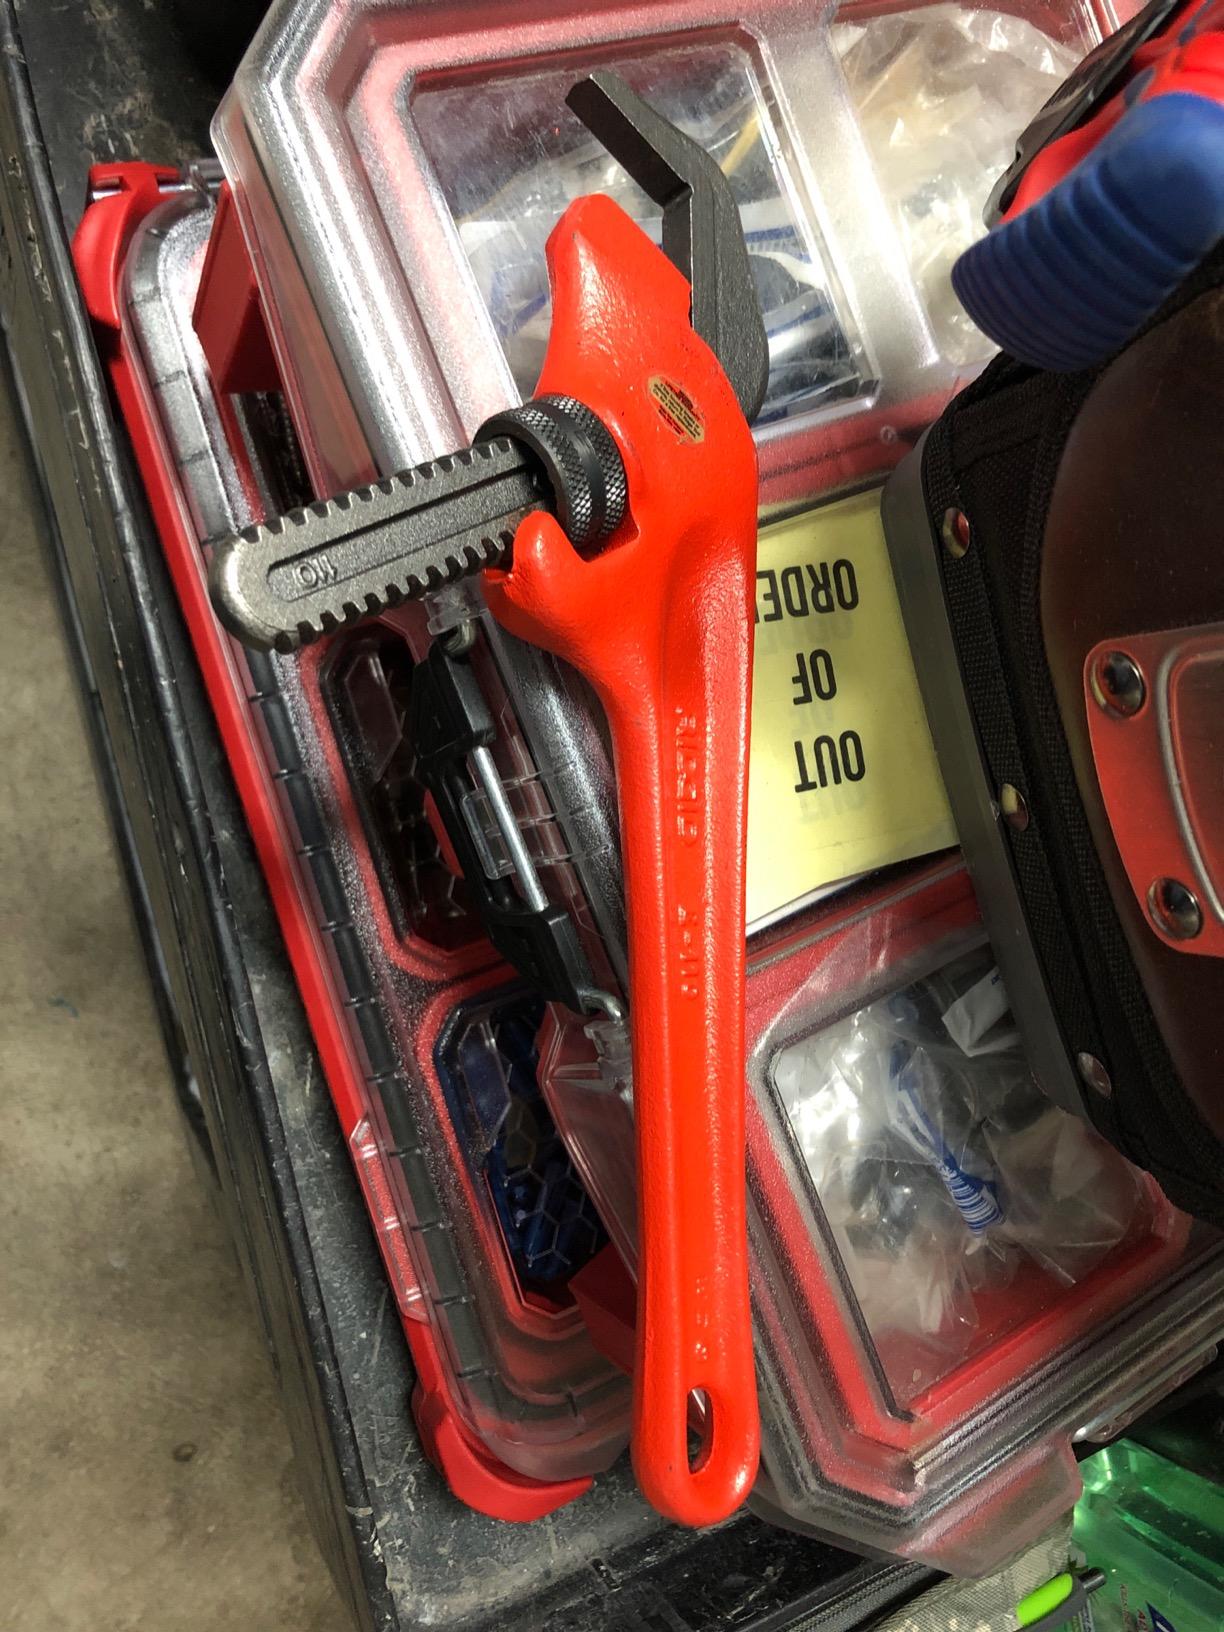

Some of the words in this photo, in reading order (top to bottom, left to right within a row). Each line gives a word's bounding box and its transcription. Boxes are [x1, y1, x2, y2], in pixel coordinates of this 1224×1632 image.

[755, 558, 859, 624] ORDE
[791, 648, 837, 705] OF
[794, 730, 866, 793] OUT
